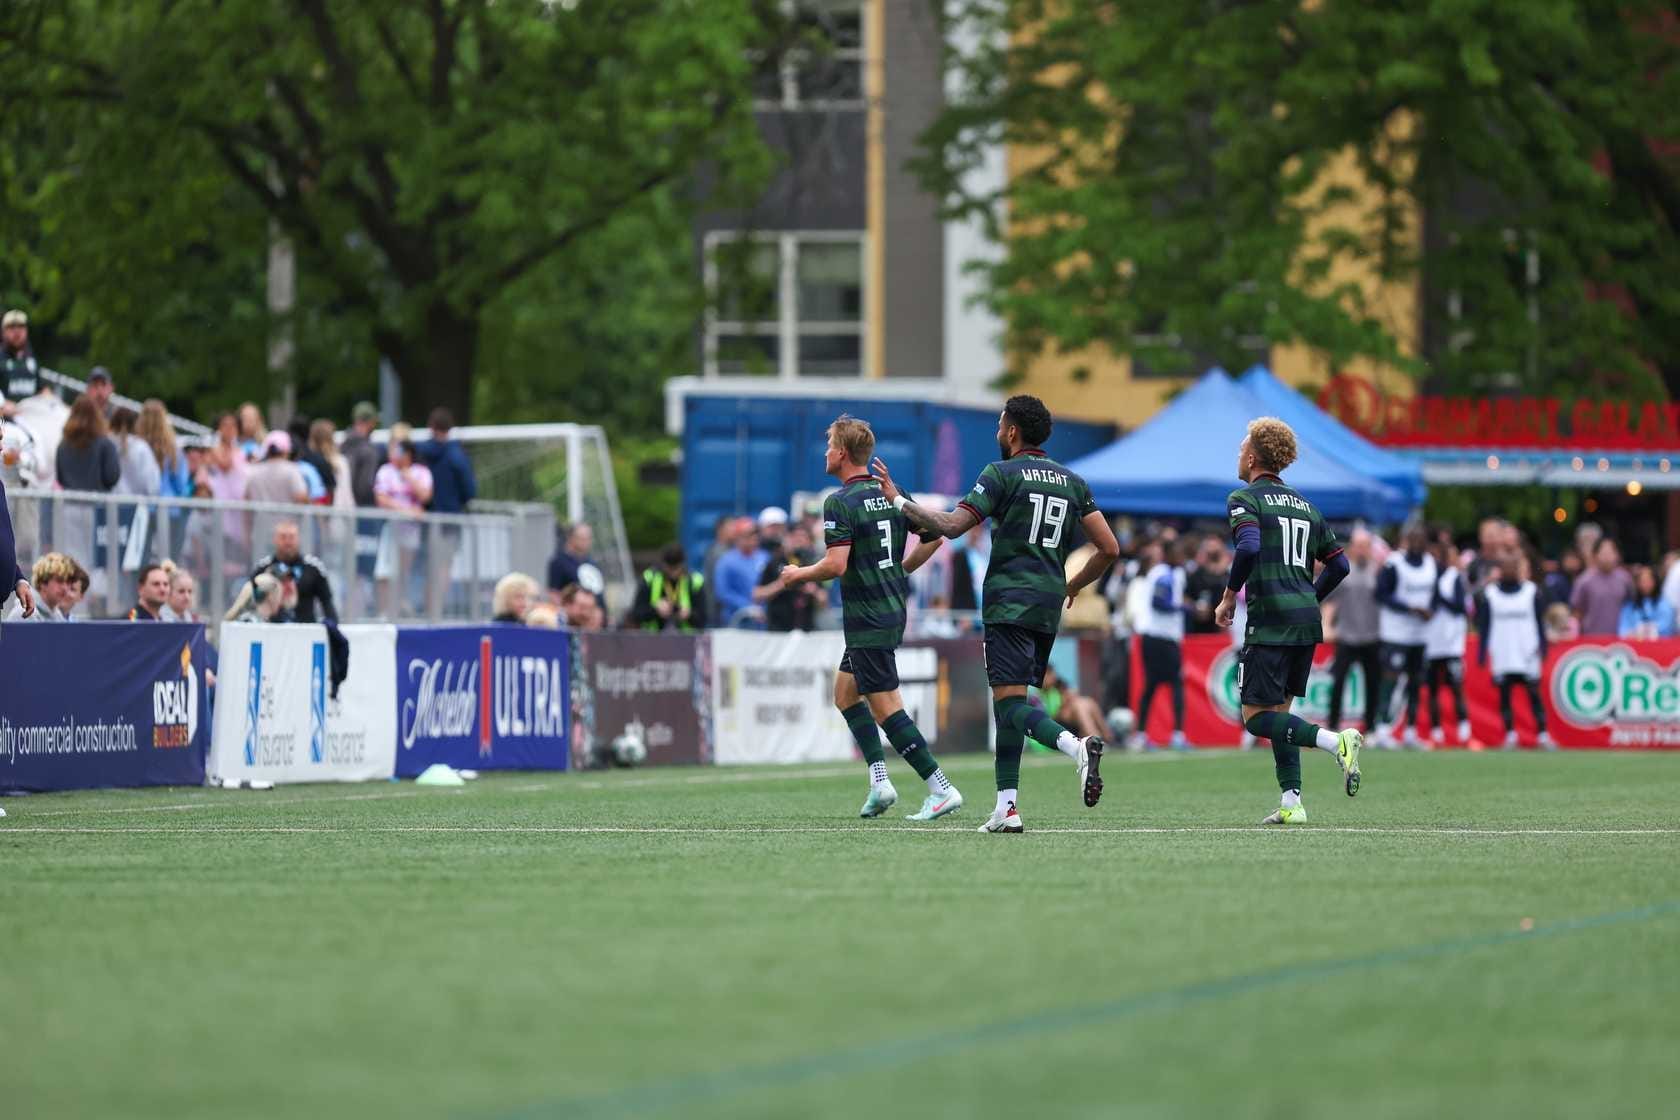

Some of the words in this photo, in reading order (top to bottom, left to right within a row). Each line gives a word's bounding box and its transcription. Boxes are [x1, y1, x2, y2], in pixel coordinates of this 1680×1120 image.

[1021, 468, 1068, 487] WRIGHT
[1028, 493, 1069, 549] 19
[1264, 494, 1312, 513] D.WRIGHT
[877, 519, 894, 570] 3
[1278, 516, 1311, 569] 10
[153, 680, 188, 724] IDEAL
[494, 655, 564, 738] ULTRA
[18, 714, 74, 755] commercial
[75, 713, 138, 752] construction.
